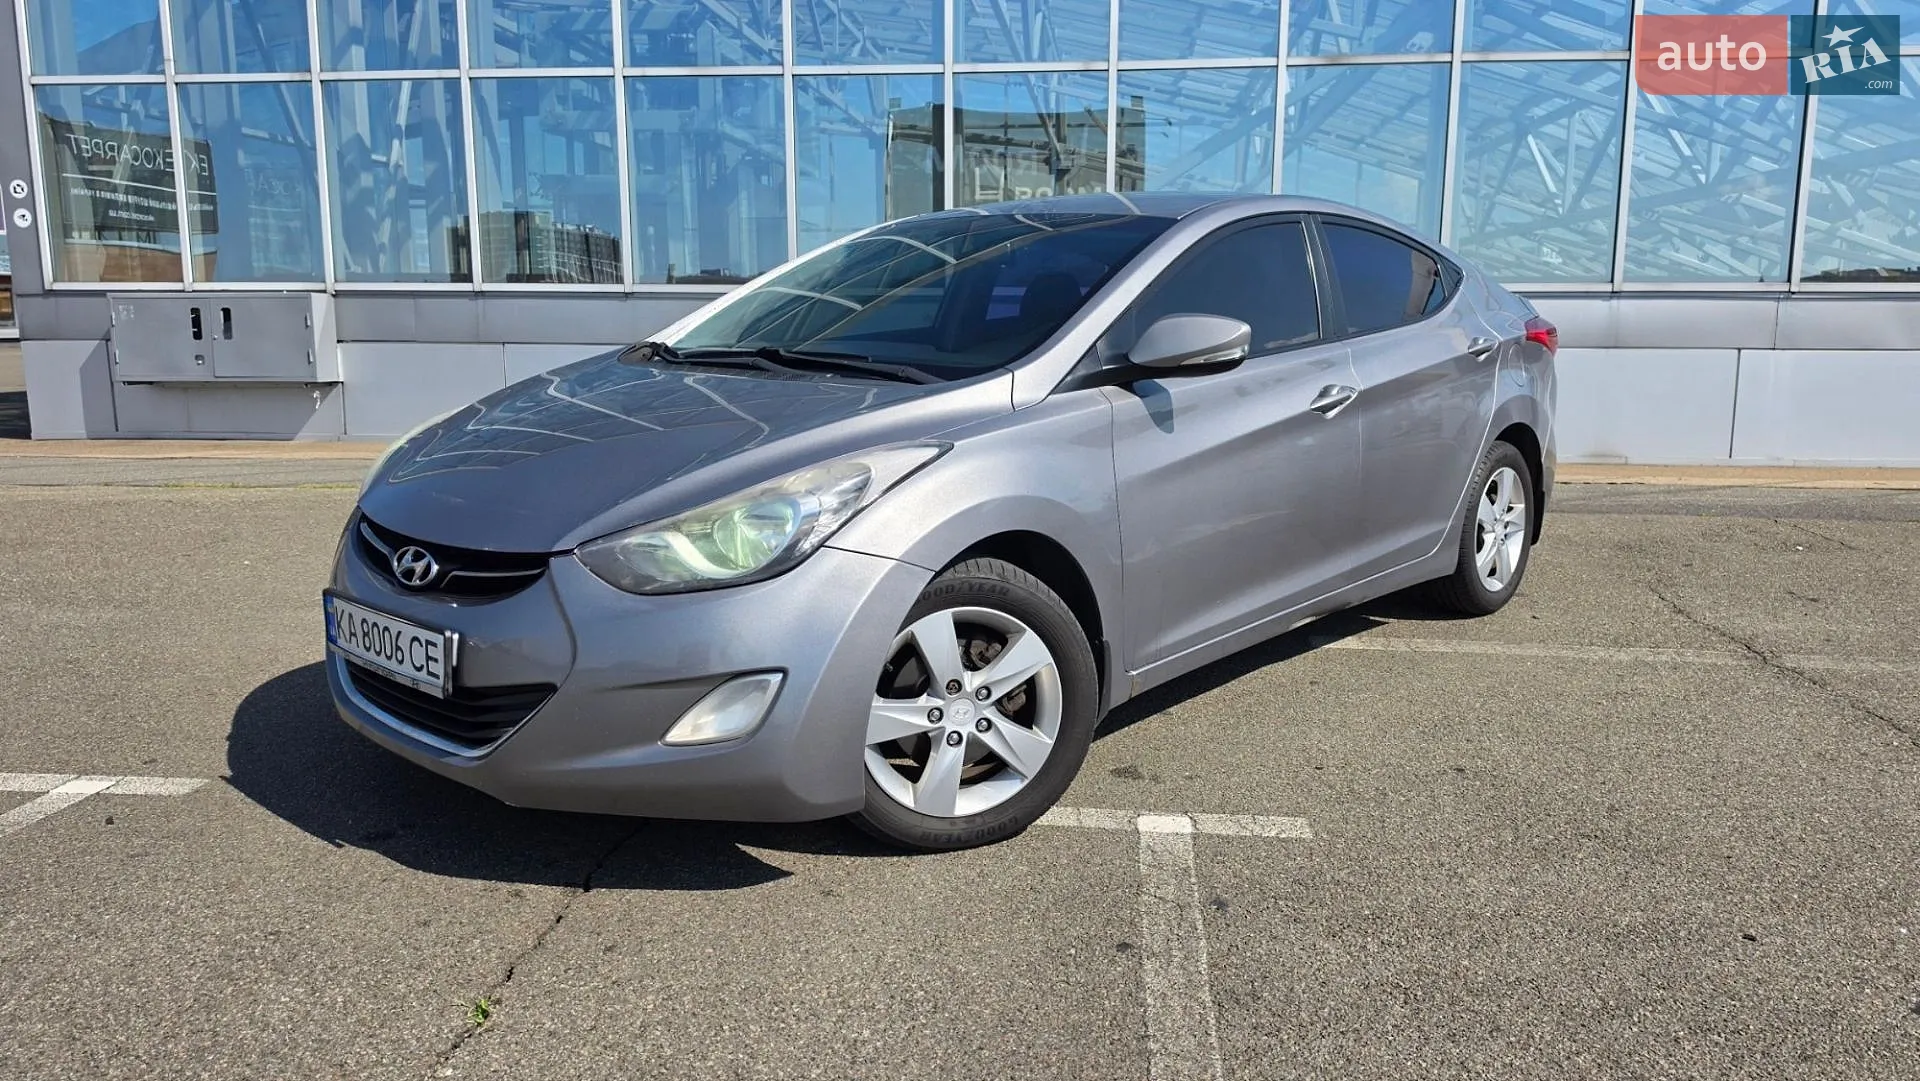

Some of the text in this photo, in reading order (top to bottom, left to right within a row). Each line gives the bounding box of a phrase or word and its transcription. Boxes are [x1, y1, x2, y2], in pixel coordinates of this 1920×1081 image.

[921, 582, 1010, 601] OODYEAR
[335, 606, 360, 648] KA
[360, 618, 405, 666] 8006
[409, 635, 441, 681] CE
